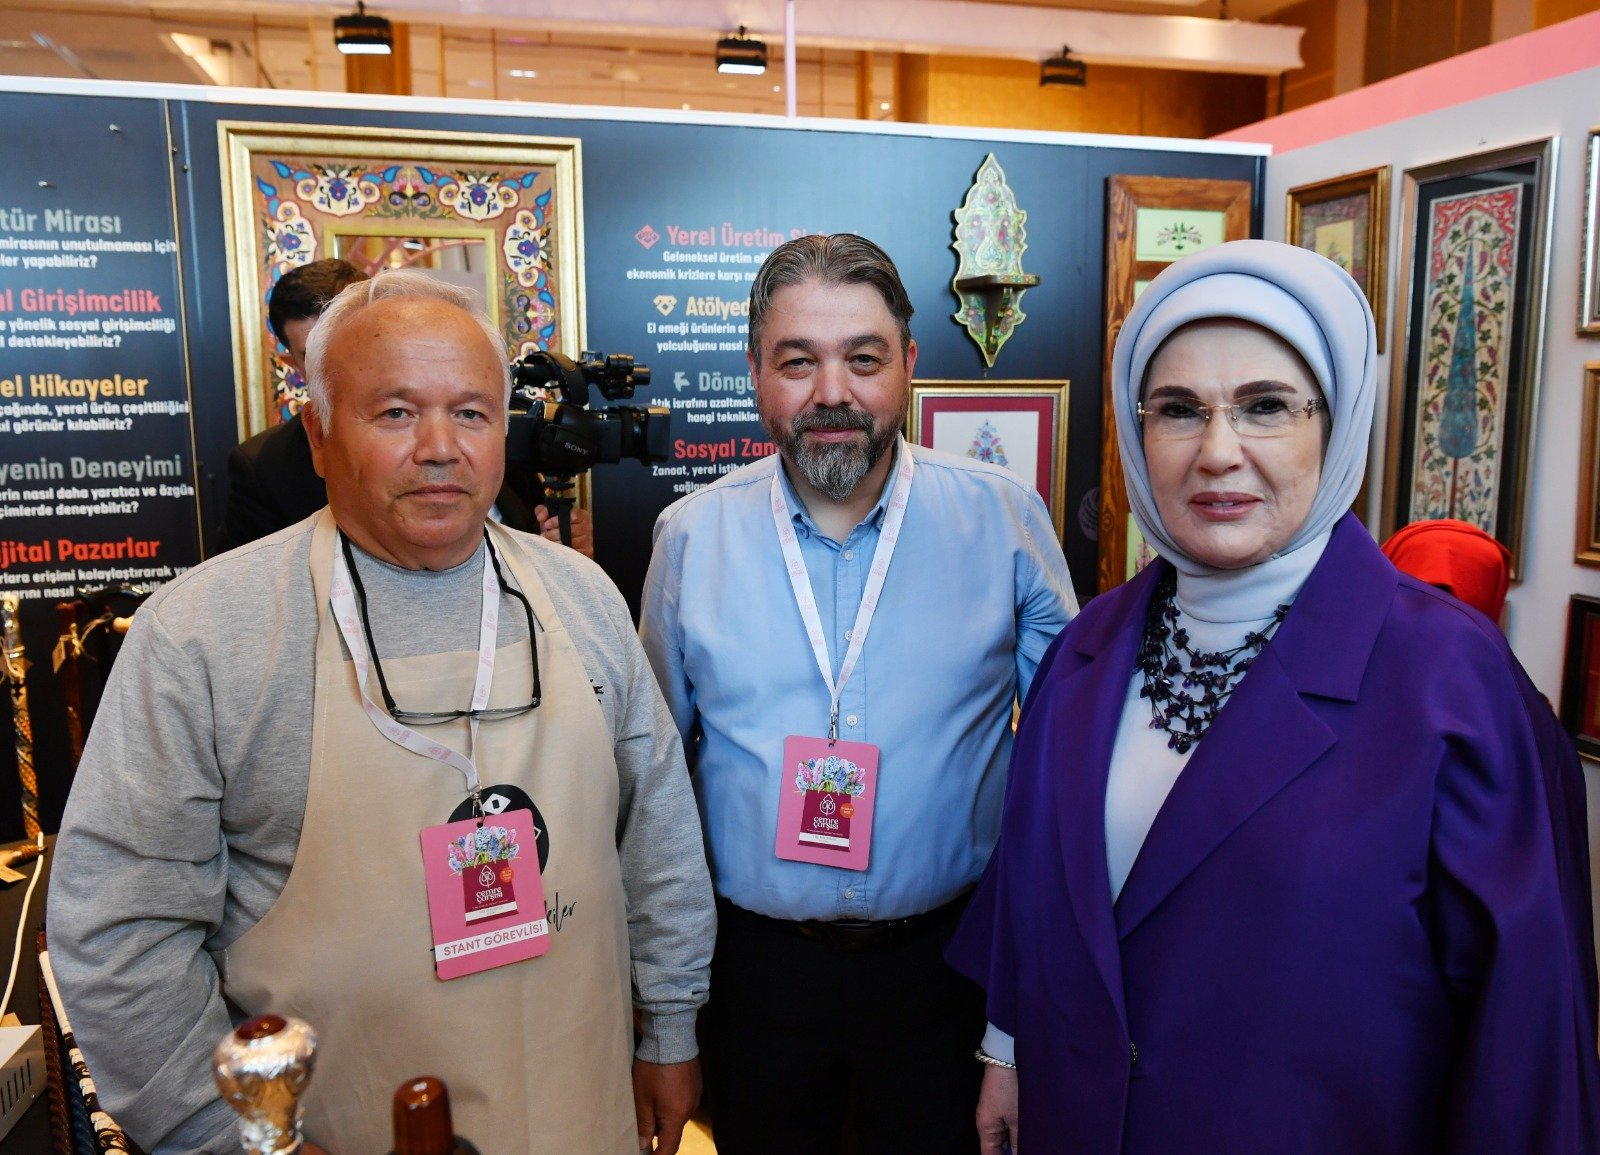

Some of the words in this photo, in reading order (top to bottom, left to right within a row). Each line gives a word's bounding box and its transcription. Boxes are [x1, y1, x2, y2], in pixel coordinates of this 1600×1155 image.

[44, 208, 122, 234] Mirası
[666, 225, 716, 246] Yerel
[721, 221, 785, 248] Üretim
[61, 239, 152, 252] unutulmaması
[154, 239, 177, 254] için
[22, 255, 98, 269] yapabiliriz?
[663, 251, 717, 263] Geleneksel
[719, 251, 752, 264] üretim
[626, 268, 676, 281] ekonomik
[678, 268, 716, 281] krizlere
[717, 269, 743, 283] karşı
[21, 289, 163, 316] Girişimcilik
[9, 318, 57, 333] yönelik
[59, 318, 100, 334] sosyal
[102, 318, 176, 334] girişimciliği
[647, 322, 657, 334] El
[658, 322, 689, 336] emeği
[690, 322, 737, 334] ürünlerin
[8, 334, 122, 350] destekleyebiliriz?
[657, 339, 718, 353] yolculuğunu
[719, 340, 743, 351] nasıl
[29, 373, 150, 402] Hikayeler
[55, 401, 88, 417] yerel
[90, 401, 120, 415] ürün
[122, 400, 190, 416] çeşitliliğini
[672, 397, 708, 409] israfını
[709, 397, 754, 409] azaltmak
[14, 418, 65, 434] görünür
[67, 418, 133, 432] kılabiliriz?
[687, 411, 715, 425] hangi
[564, 442, 589, 455] SONY
[674, 438, 736, 462] Sosyal
[70, 454, 182, 483] Deneyimi
[652, 465, 690, 477] Zanaat,
[691, 464, 717, 478] yerel
[23, 487, 54, 501] nasıl
[56, 486, 89, 500] daha
[91, 486, 140, 501] yaratıcı
[142, 486, 157, 497] ve
[159, 483, 195, 498] özgün
[58, 537, 161, 562] Pazarlar
[33, 569, 76, 584] erişimi
[78, 565, 172, 582] kolaylaştırarak
[44, 585, 74, 599] nasıl
[443, 938, 482, 956] STANT
[484, 920, 543, 947] GÖREVLİSİ
